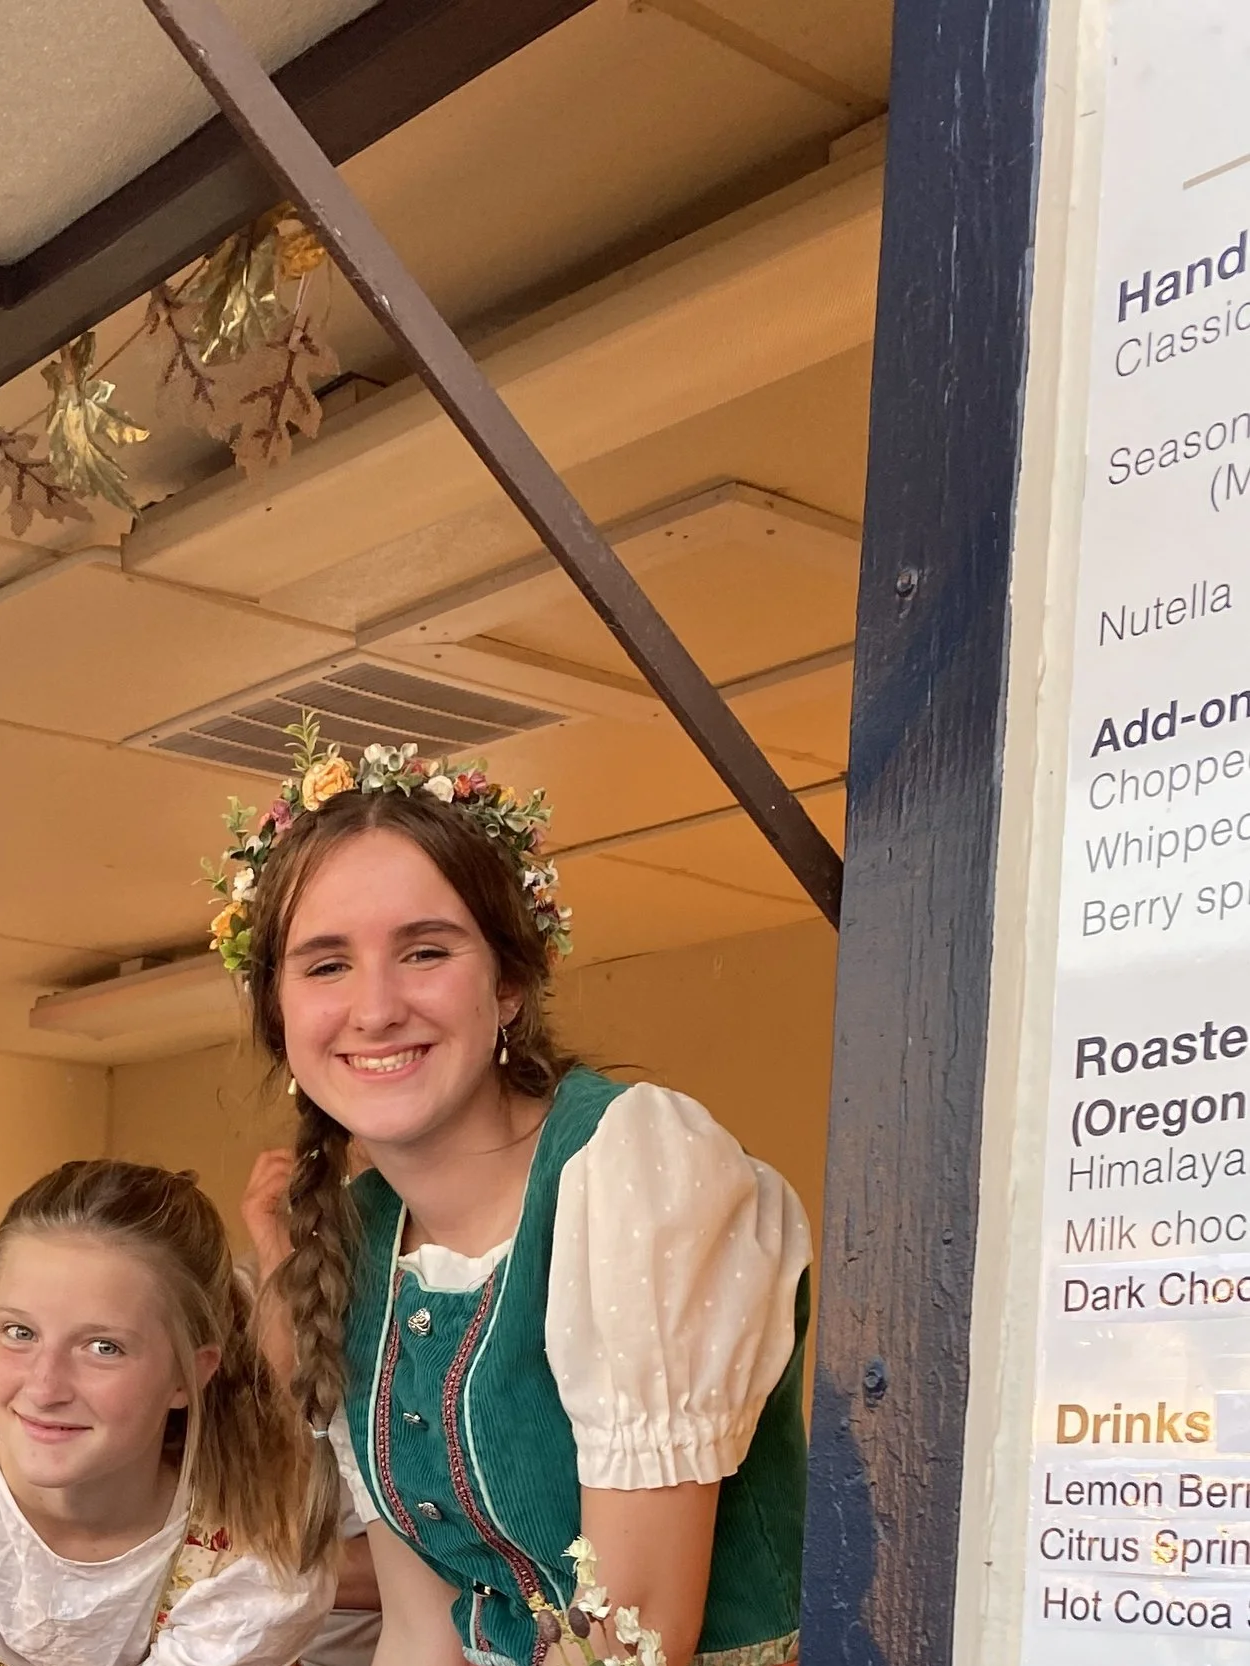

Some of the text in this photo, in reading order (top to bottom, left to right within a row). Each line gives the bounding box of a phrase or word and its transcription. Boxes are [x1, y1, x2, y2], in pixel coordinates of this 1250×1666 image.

[1117, 229, 1248, 323] Hand
[1115, 300, 1250, 377] Classic
[1108, 412, 1250, 485] Season
[1099, 580, 1232, 646] Nutella
[1090, 690, 1250, 758] Add-on
[1089, 750, 1250, 810] Choppe
[1083, 880, 1250, 937] Berry sp
[1075, 1021, 1249, 1079] Roaste
[1071, 1091, 1246, 1147] (Oregon
[1068, 1147, 1247, 1192] Himalaya
[1065, 1210, 1247, 1254] Milk choc
[1064, 1276, 1146, 1313] Dark
[1056, 1402, 1211, 1444] Drinks
[1045, 1472, 1163, 1507] Lemon
[1040, 1527, 1250, 1572] Citrus Sprin
[1043, 1586, 1102, 1621] Hot
[1114, 1590, 1232, 1629] Cocoa
